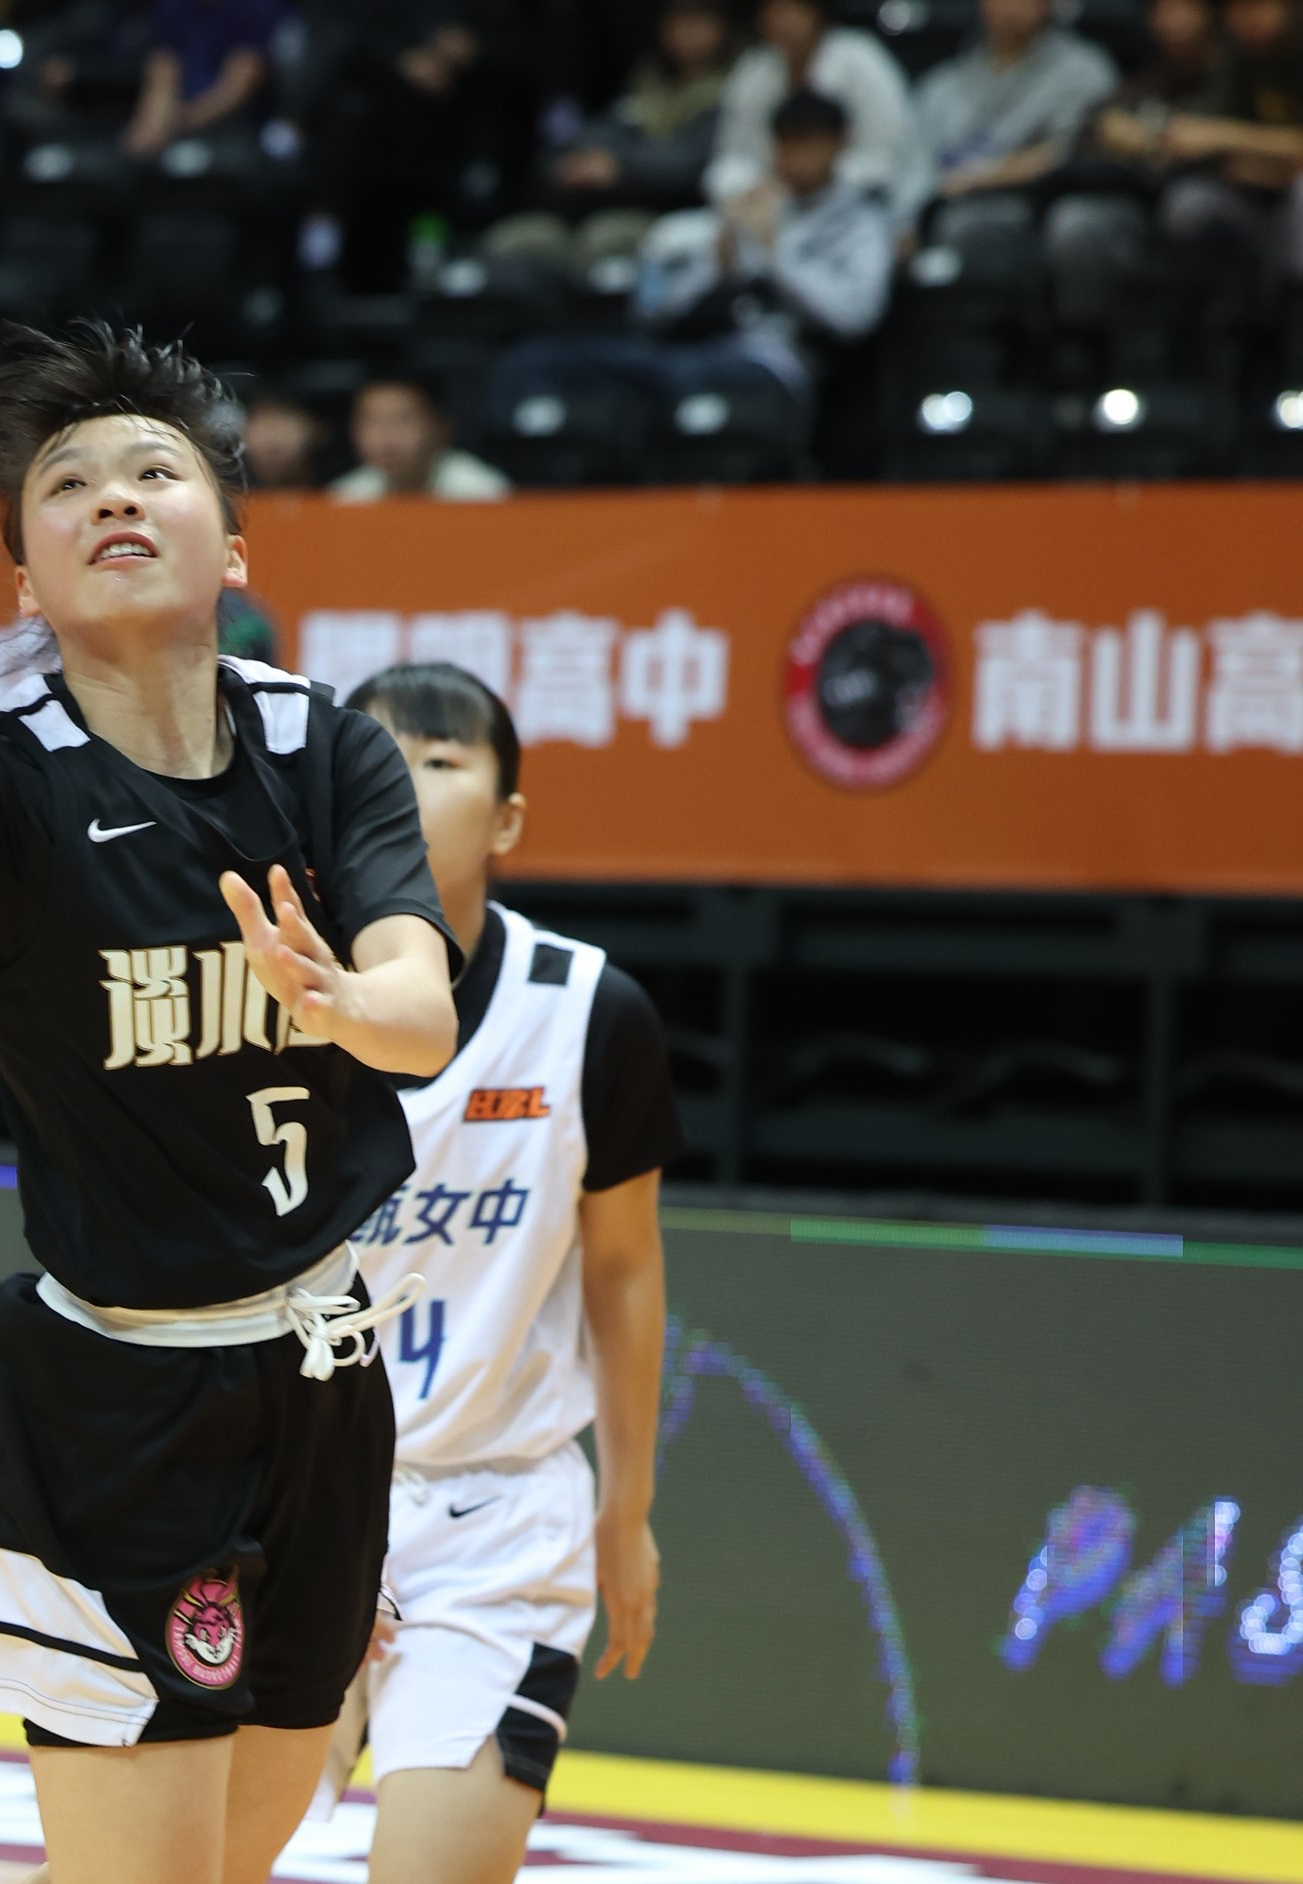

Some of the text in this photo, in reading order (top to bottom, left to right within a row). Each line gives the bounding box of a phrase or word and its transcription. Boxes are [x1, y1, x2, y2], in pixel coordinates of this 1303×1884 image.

[972, 609, 1303, 754] 南山高
[98, 942, 335, 1070] 淡水
[246, 1086, 310, 1217] 5
[398, 1299, 446, 1400] 4
